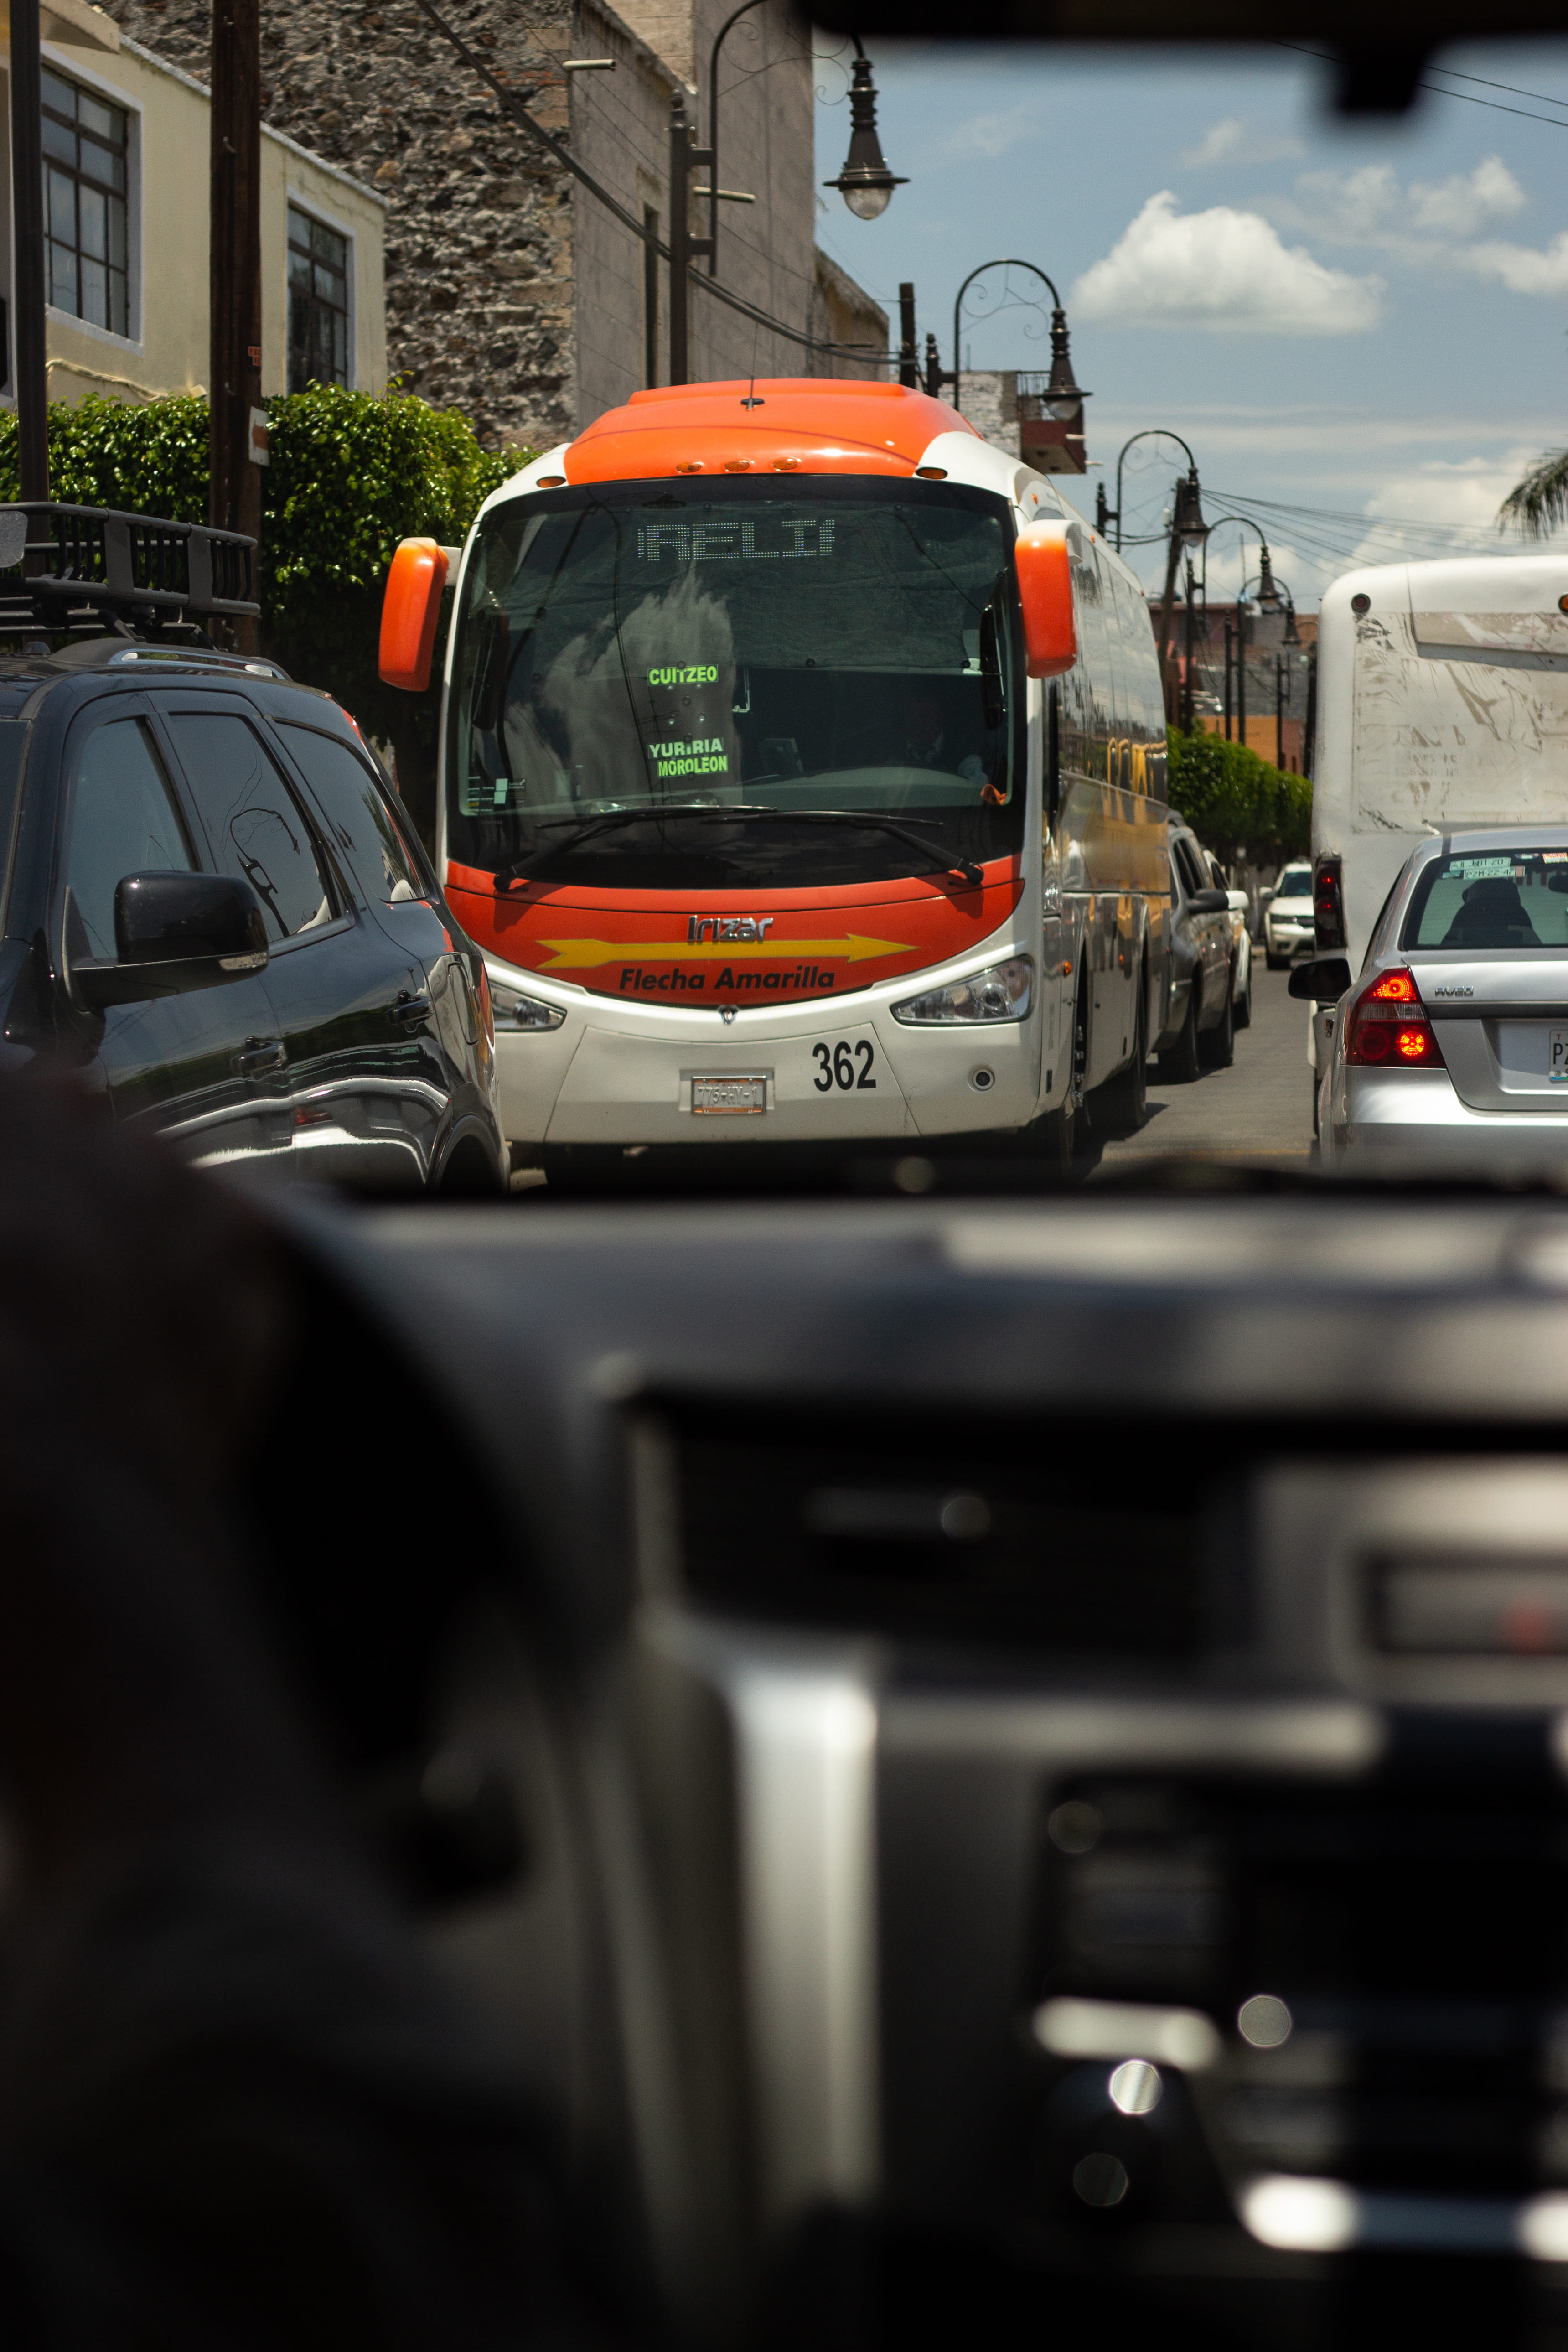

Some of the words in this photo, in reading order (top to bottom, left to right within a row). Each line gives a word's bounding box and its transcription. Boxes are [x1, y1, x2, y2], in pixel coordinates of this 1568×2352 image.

[649, 666, 717, 684] CUITZEO
[649, 738, 723, 758] YURIRIA
[658, 756, 727, 777] MOROLEON
[619, 967, 705, 990] Flecha
[714, 965, 835, 990] Amarilla
[812, 1040, 876, 1092] 362
